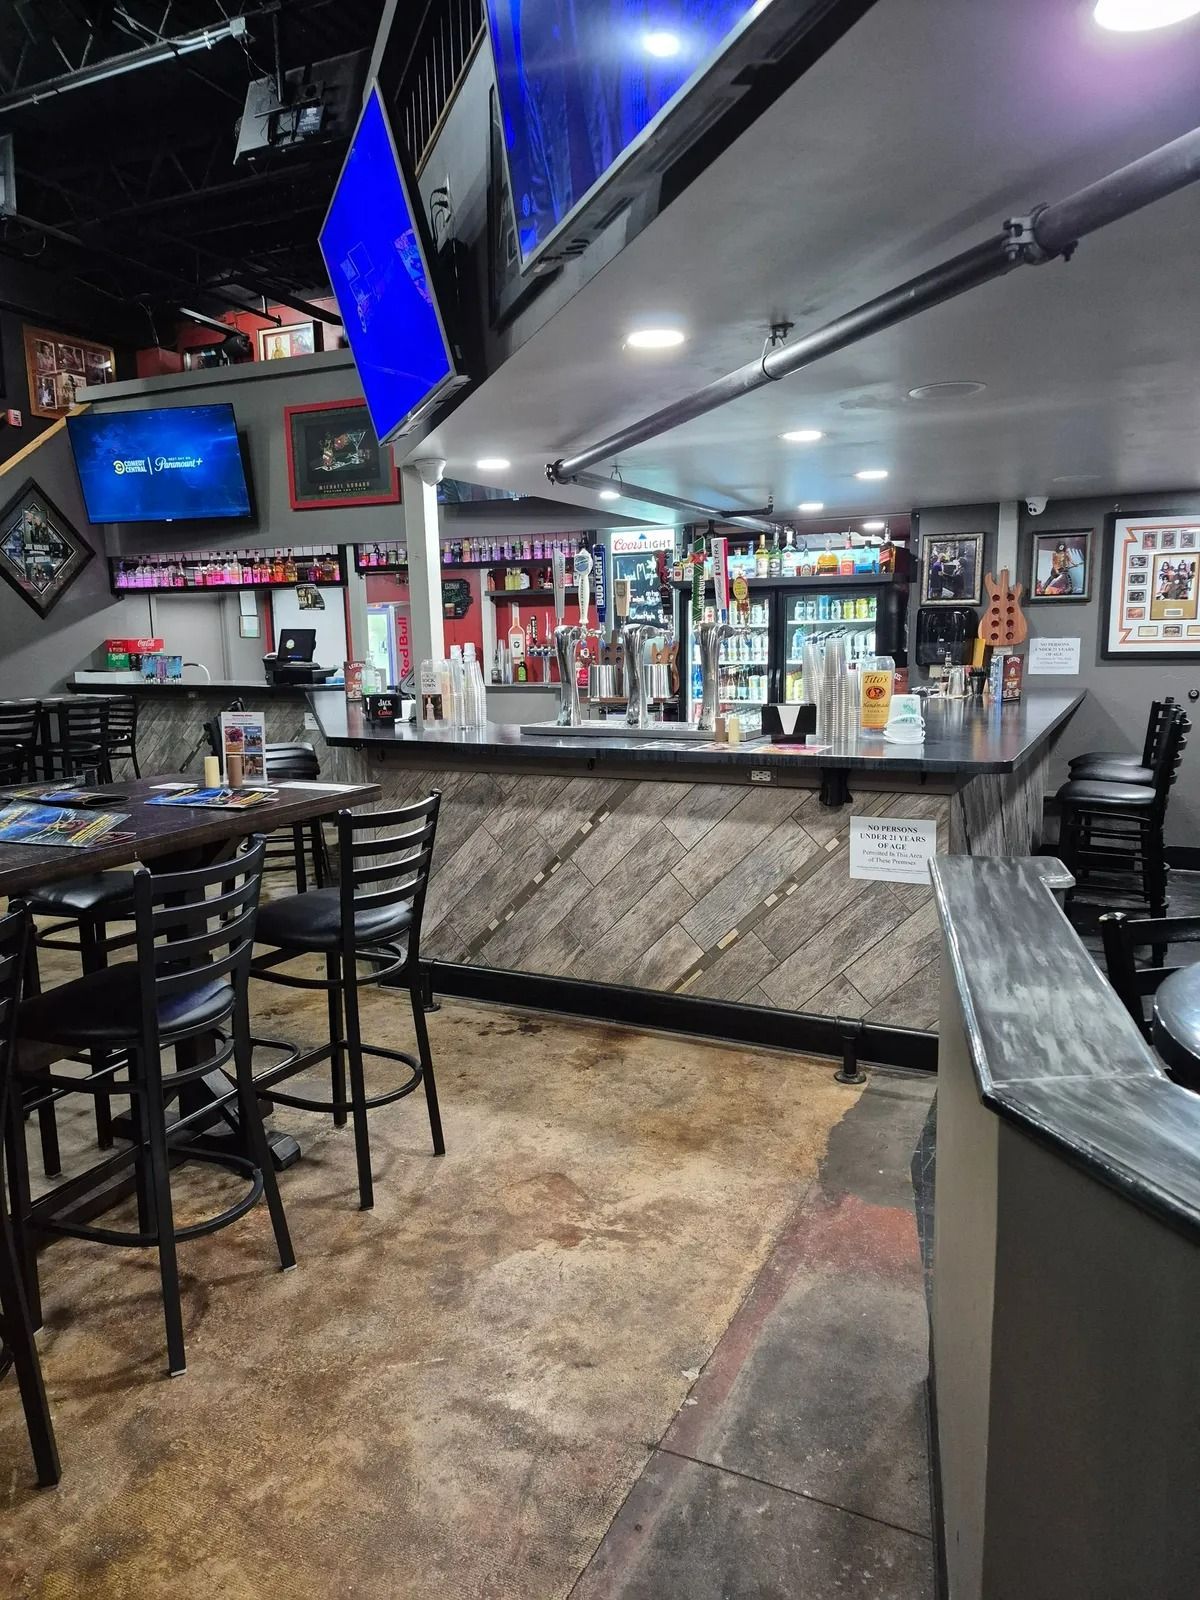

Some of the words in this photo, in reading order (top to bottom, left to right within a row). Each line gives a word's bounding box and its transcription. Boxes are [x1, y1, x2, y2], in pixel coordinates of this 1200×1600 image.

[614, 538, 642, 551] Coors
[644, 540, 671, 549] LIGHT
[595, 556, 603, 584] LIGHT
[398, 617, 408, 648] Bull
[400, 648, 410, 678] Red
[865, 674, 888, 684] Tito's
